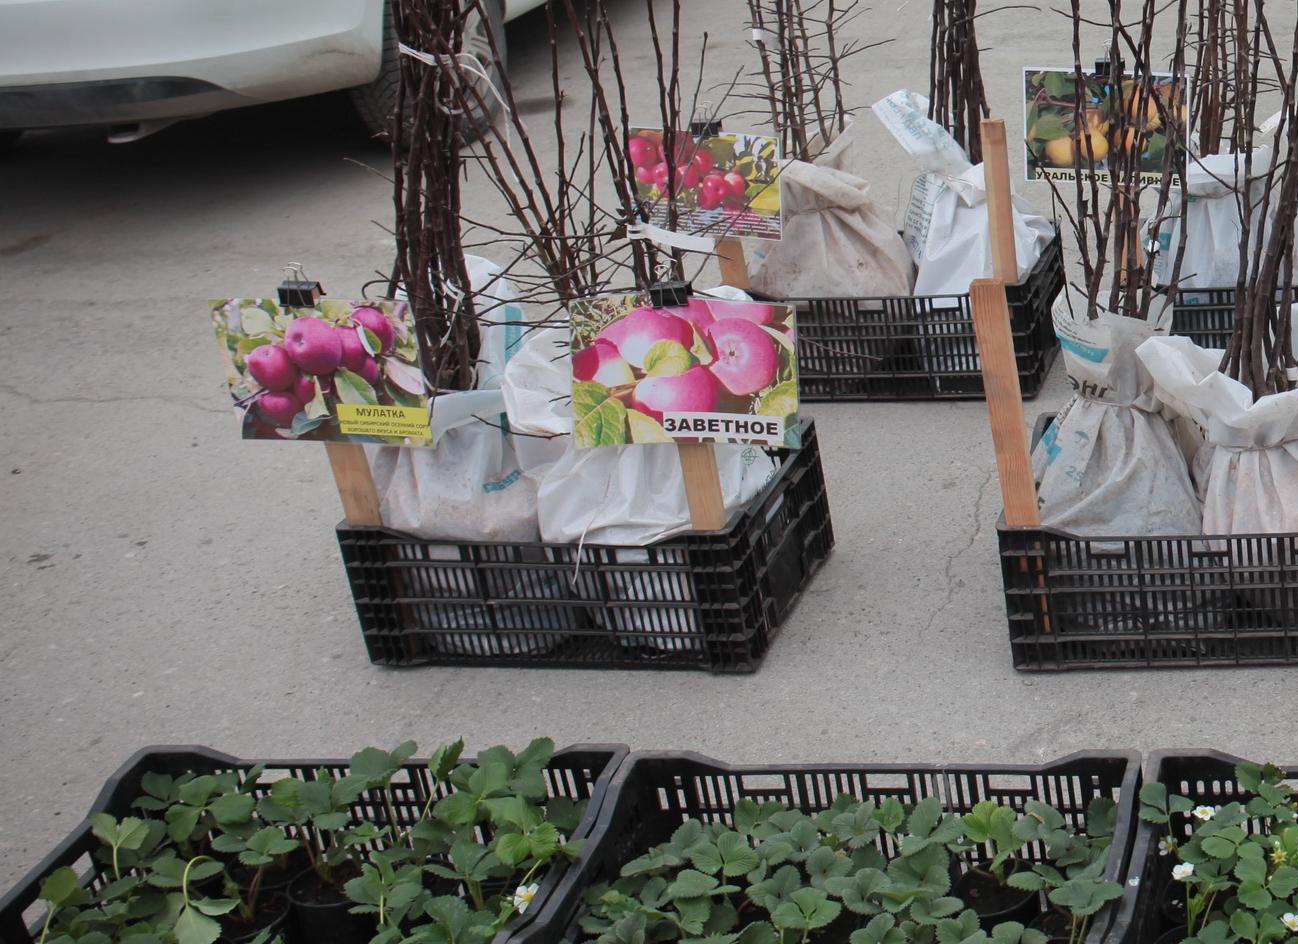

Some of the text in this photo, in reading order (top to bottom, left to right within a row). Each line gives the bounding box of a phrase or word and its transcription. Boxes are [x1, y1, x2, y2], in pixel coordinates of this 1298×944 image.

[1116, 174, 1180, 186] АИВНЕ
[356, 408, 405, 418] МУЛАТКА
[664, 417, 779, 436] ЗАВЕТНОЕ
